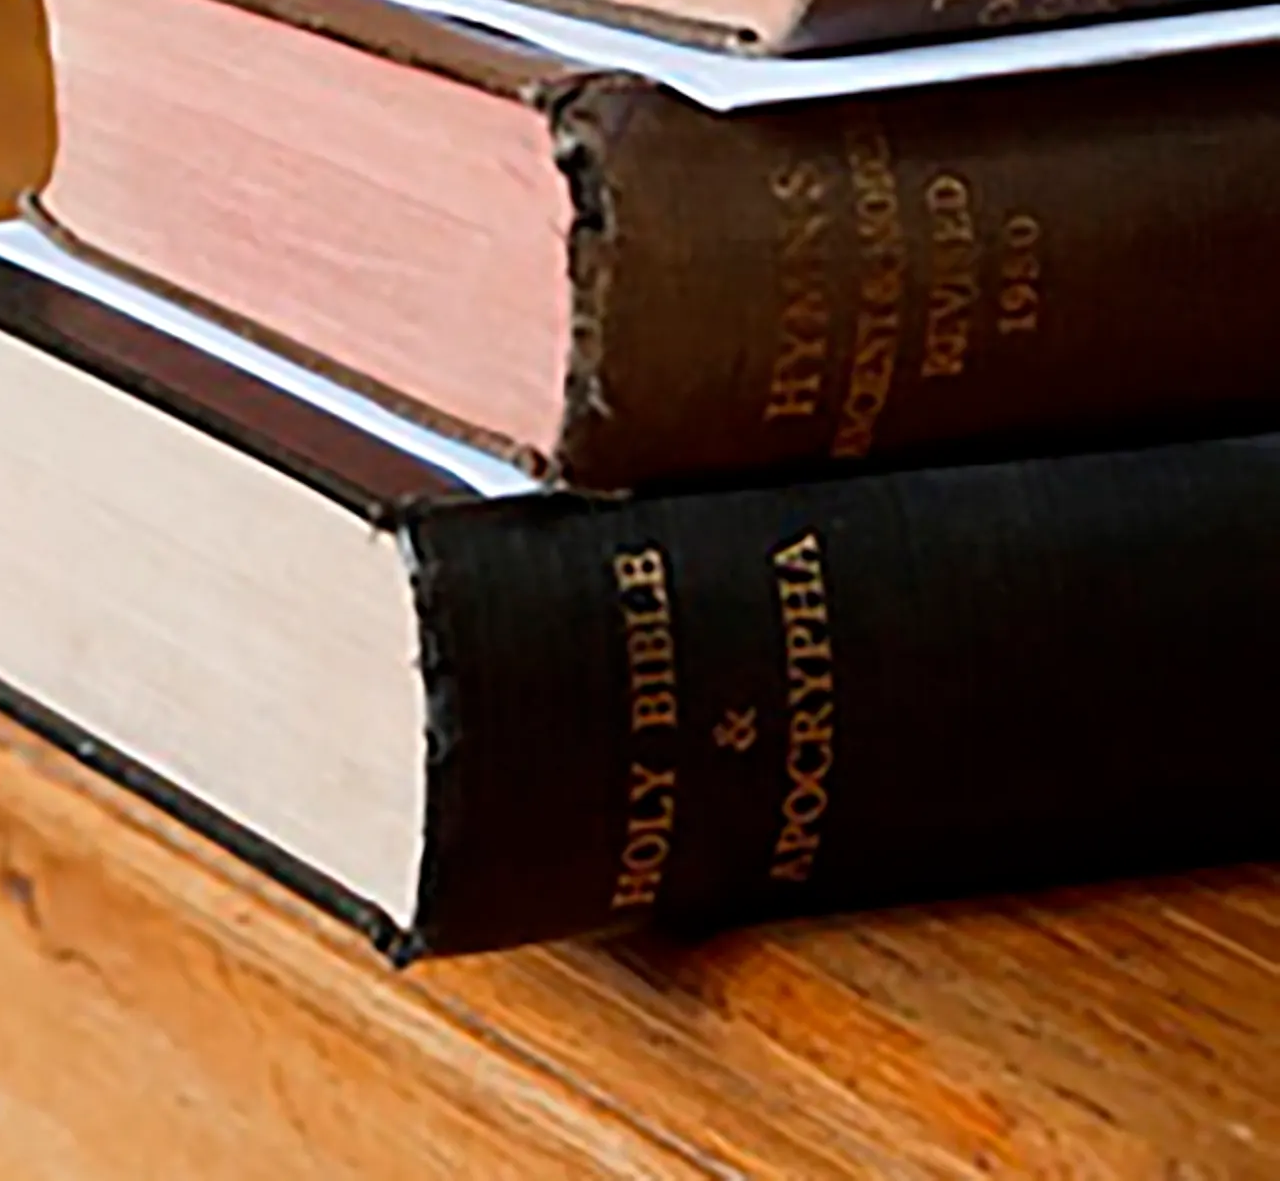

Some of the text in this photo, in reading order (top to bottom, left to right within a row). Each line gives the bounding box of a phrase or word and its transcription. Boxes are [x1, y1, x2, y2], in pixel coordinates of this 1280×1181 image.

[765, 161, 830, 421] HYMNS
[996, 215, 1040, 334] 1950
[612, 547, 678, 909] HOLY BIBLE
[713, 706, 757, 751] &
[769, 532, 835, 881] APOCRYPHA
